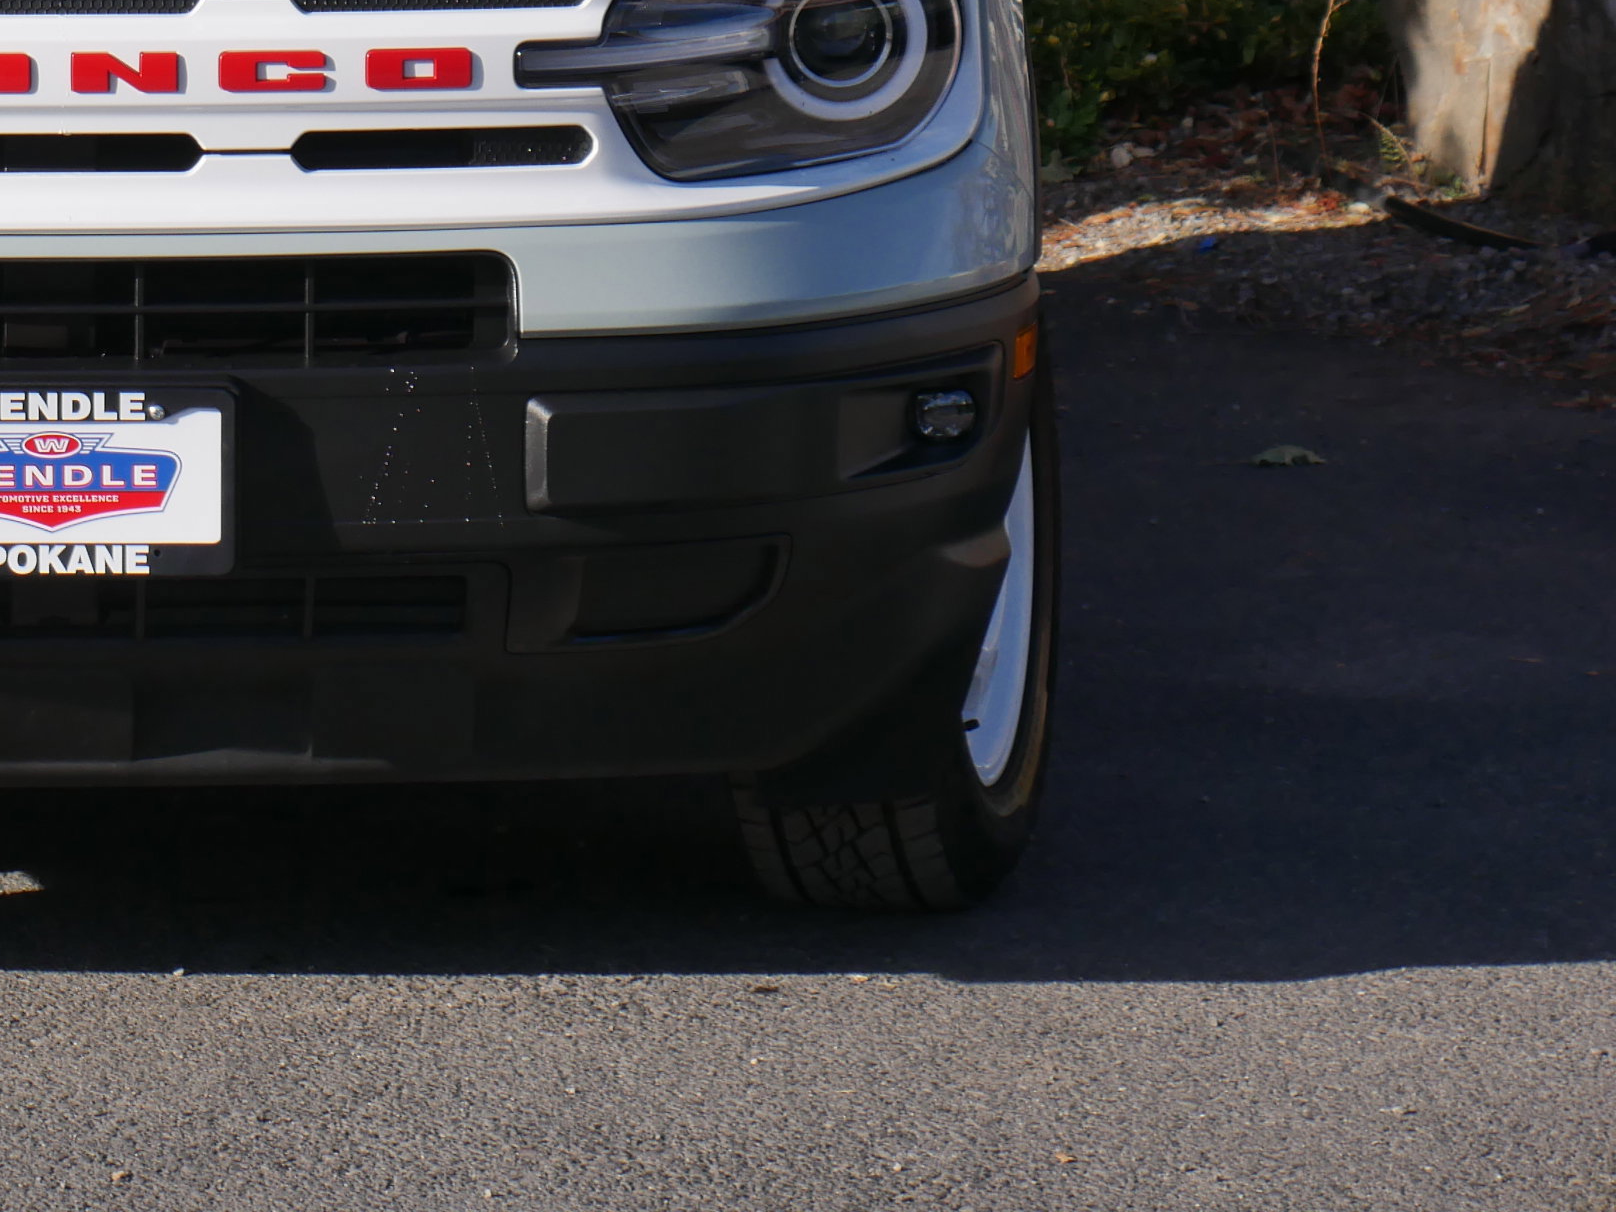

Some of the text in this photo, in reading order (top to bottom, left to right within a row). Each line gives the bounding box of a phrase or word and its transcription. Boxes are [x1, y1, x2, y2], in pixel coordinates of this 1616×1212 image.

[34, 438, 69, 453] W
[52, 494, 119, 503] EXCELLENCE
[22, 505, 82, 514] SINCE 1943
